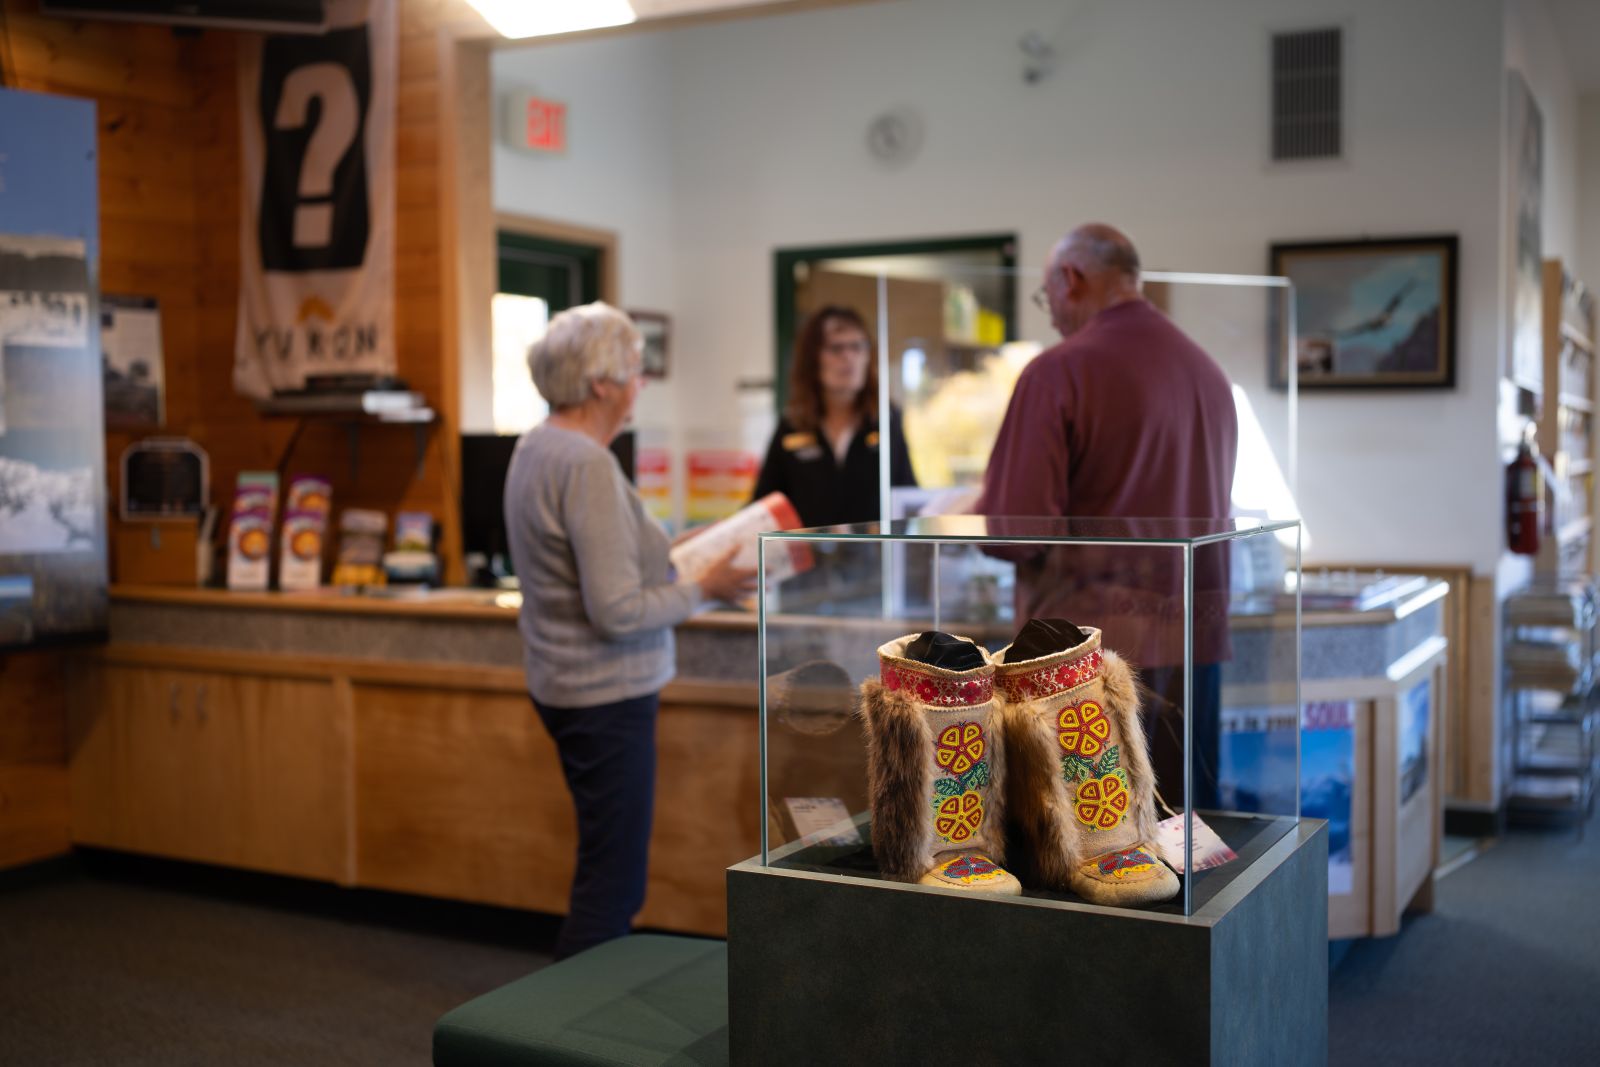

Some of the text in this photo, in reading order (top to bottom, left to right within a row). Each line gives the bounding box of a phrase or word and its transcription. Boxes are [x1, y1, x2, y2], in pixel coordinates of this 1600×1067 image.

[526, 98, 567, 153] EXIT
[275, 62, 360, 247] ?
[254, 324, 377, 363] YUKON
